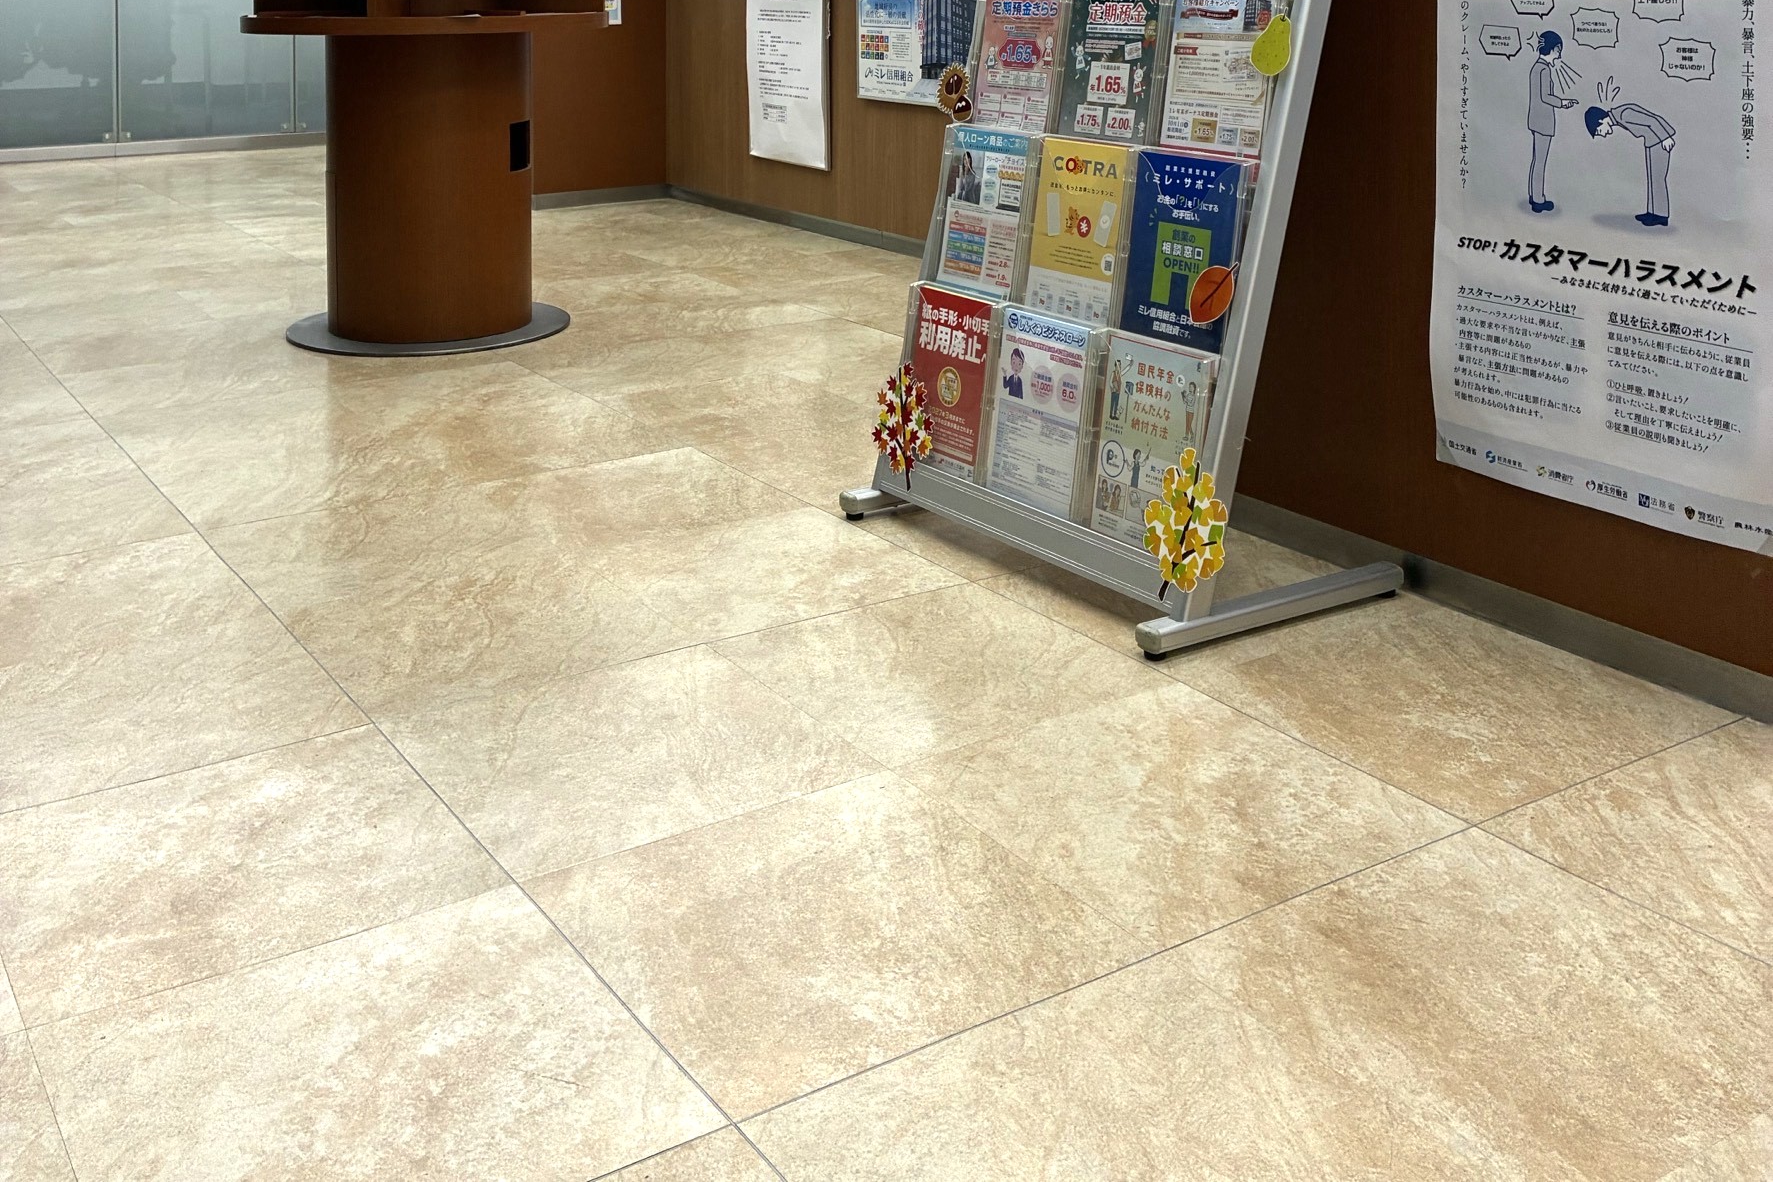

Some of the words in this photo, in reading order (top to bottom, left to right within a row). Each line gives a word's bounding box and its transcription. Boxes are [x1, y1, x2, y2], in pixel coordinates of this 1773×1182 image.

[991, 1, 1059, 17] 定期預金きらら
[1088, 3, 1147, 24] 定期預金
[874, 67, 914, 83] ミレ信用組合
[1668, 63, 1705, 71] じゃないのか!
[1090, 74, 1126, 94] 年1.65%
[1172, 229, 1196, 243] 創業の
[1161, 241, 1204, 261] 相談窓口
[1163, 261, 1200, 274] OPEN!!
[1457, 236, 1498, 254] STOP!
[1499, 238, 1757, 300] カスタマーハラスメント
[1458, 285, 1577, 316] カスタマーハラスメントとは?
[1137, 304, 1213, 331] ミレ信用組合と日本の
[1456, 304, 1563, 330] カスタマーハラスメントとは、例えば、
[1608, 311, 1730, 344] 意見を伝える際のポイント
[1018, 319, 1087, 348] しんくみビジネスローン
[1459, 329, 1532, 350] 内容等に問題があるもの
[1607, 331, 1751, 368] 意見がきちんと相手に伝わるように、従業員
[1137, 362, 1175, 385] 国民年金
[1454, 366, 1501, 383] が考えられます。
[1458, 354, 1569, 385] 暴言など、主張方法に問題があるもの
[1607, 346, 1749, 382] に意見を伝える際には、以下の点を意識し
[1608, 359, 1658, 378] てみてください。
[1135, 381, 1172, 402] 保険料の
[1454, 378, 1582, 415] 暴力行為を始め、中には犯罪行為に当たる
[1133, 400, 1171, 422] かんたんな
[1454, 391, 1544, 419] 可能性のあるものも含まれます。
[1131, 417, 1169, 441] 納付方法
[1449, 440, 1477, 456] 国土交通省
[1548, 469, 1574, 483] 消費者庁
[1597, 483, 1628, 499] 厚生労働省
[1650, 497, 1675, 511] 法務省
[1698, 510, 1724, 525] 警察庁
